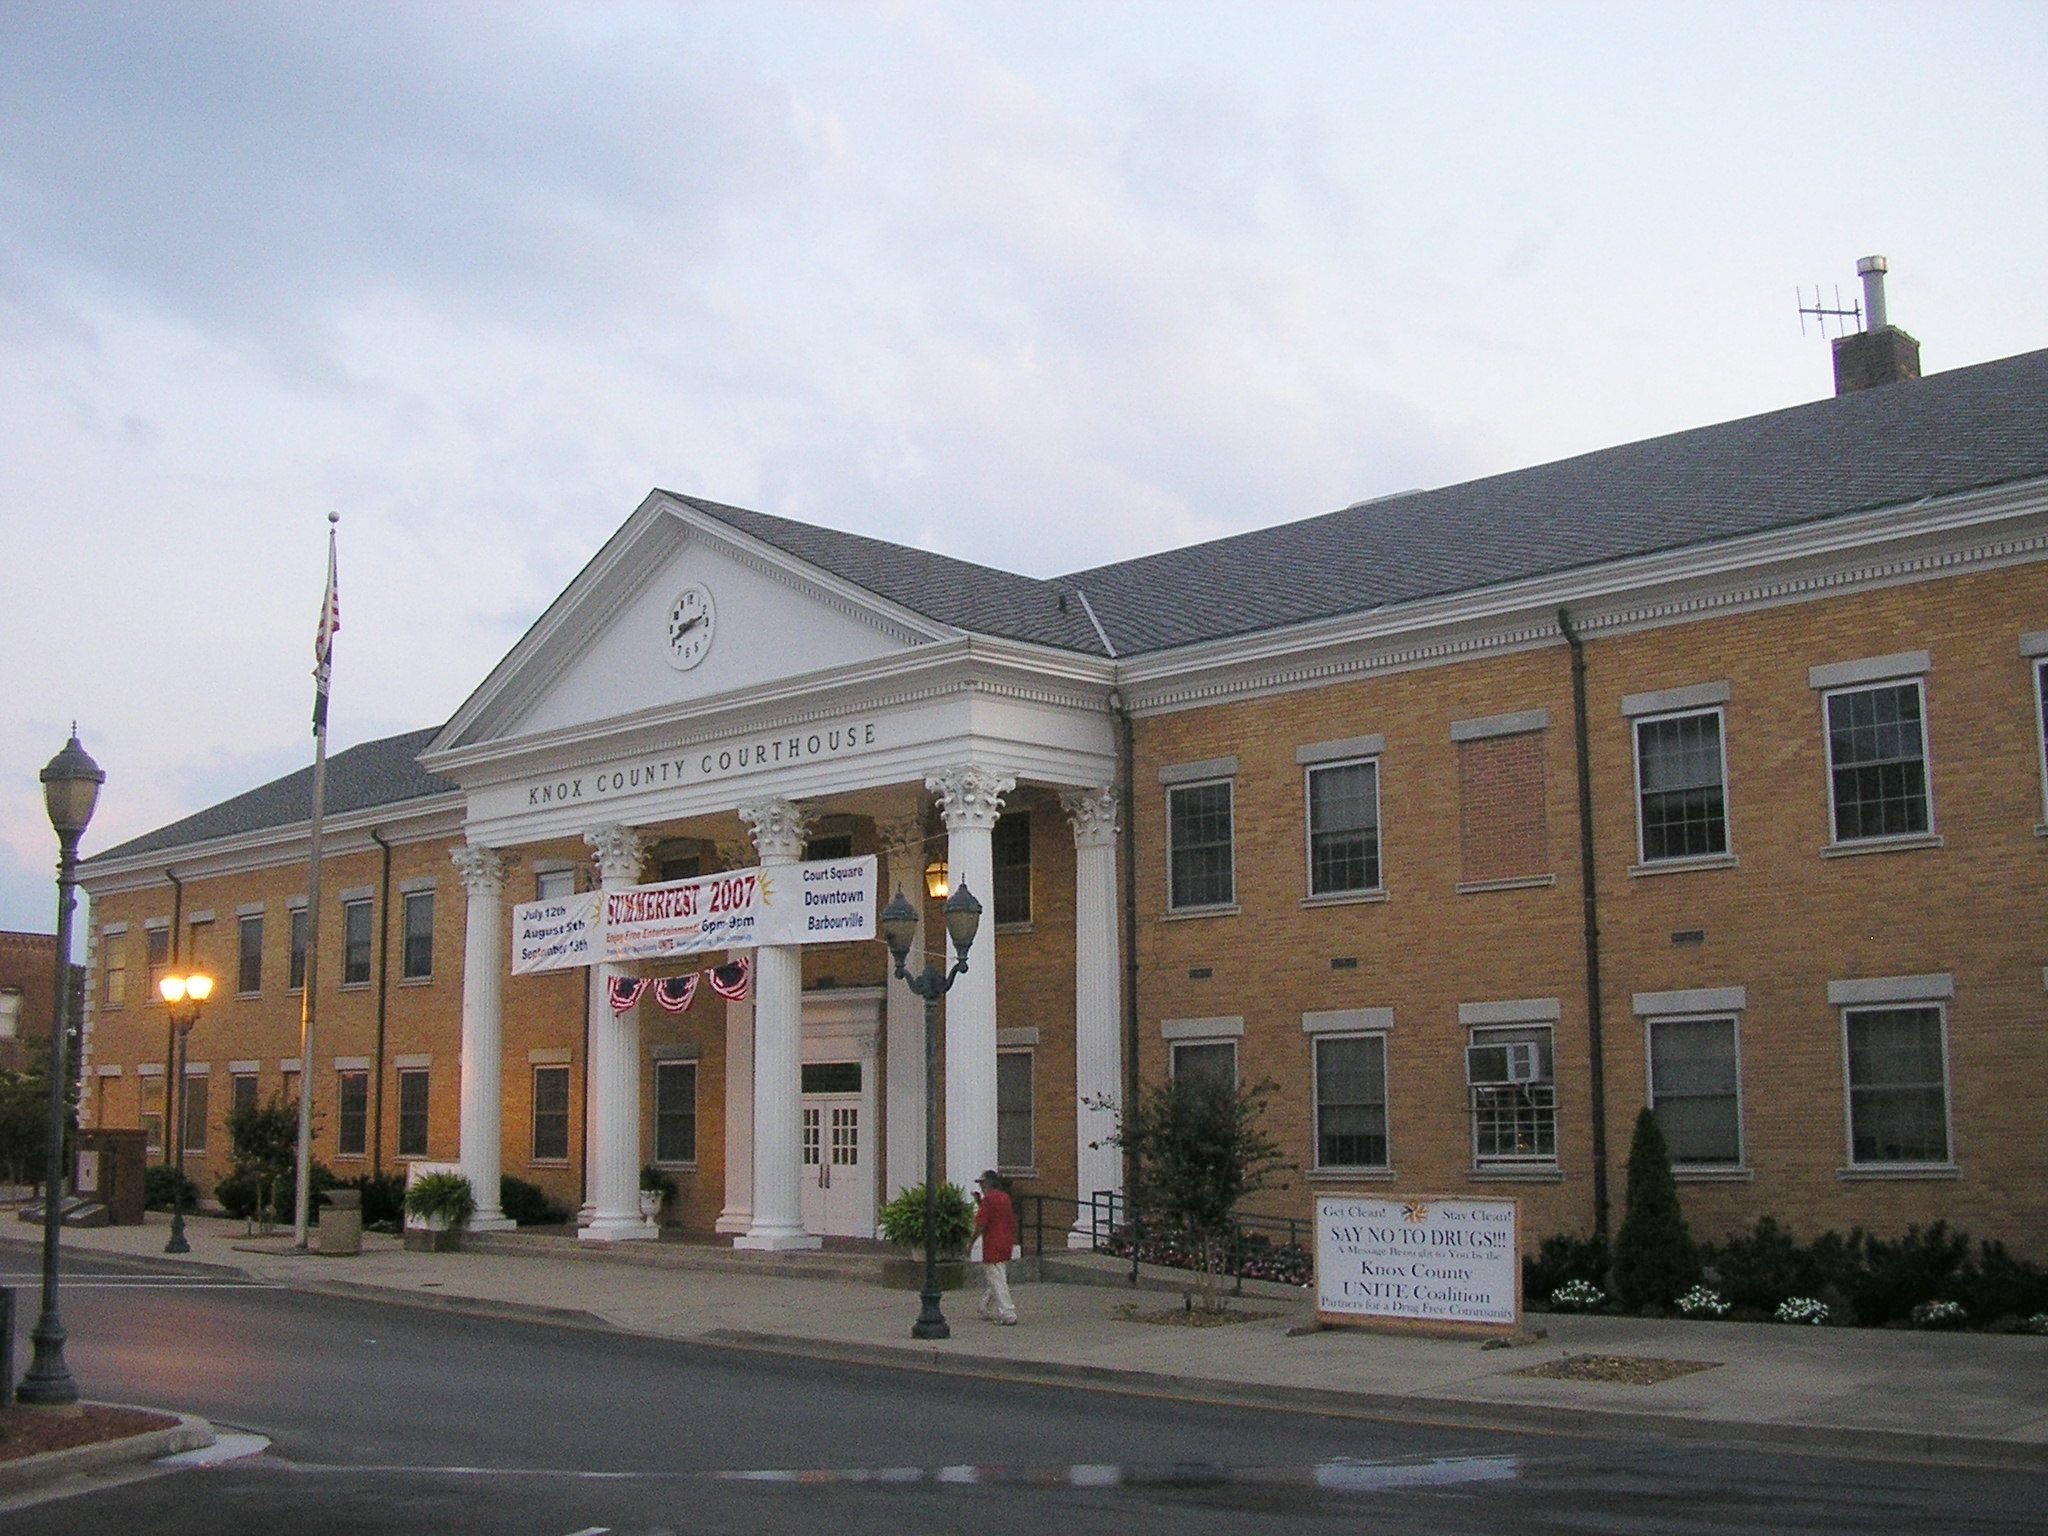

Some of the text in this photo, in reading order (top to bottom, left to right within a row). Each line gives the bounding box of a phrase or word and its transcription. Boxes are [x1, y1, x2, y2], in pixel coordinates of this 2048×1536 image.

[528, 723, 875, 805] KNOX COUNTY COURTHOUSE
[803, 866, 863, 883] Court Square
[607, 875, 756, 927] SUMMERFEST 2007
[804, 889, 864, 907] Downtown
[523, 906, 566, 921] July 12th
[808, 913, 864, 931] Barbourville
[523, 920, 585, 940] August 5th
[625, 930, 641, 940] Free
[1323, 1206, 1386, 1218] Get Clean!
[1442, 1210, 1512, 1222] Stay Clean!
[1330, 1226, 1506, 1248] SAY NO TO DRUGS!!!
[1348, 1246, 1386, 1256] Message
[1448, 1250, 1469, 1259] You
[1486, 1251, 1501, 1260] the
[1361, 1261, 1473, 1283] Knox County
[1343, 1281, 1491, 1304] UNITE Coalition
[1321, 1297, 1363, 1309] Partners
[1365, 1299, 1380, 1310] for
[1392, 1301, 1420, 1314] Drug
[1422, 1302, 1446, 1314] Free
[1449, 1304, 1513, 1320] Community
